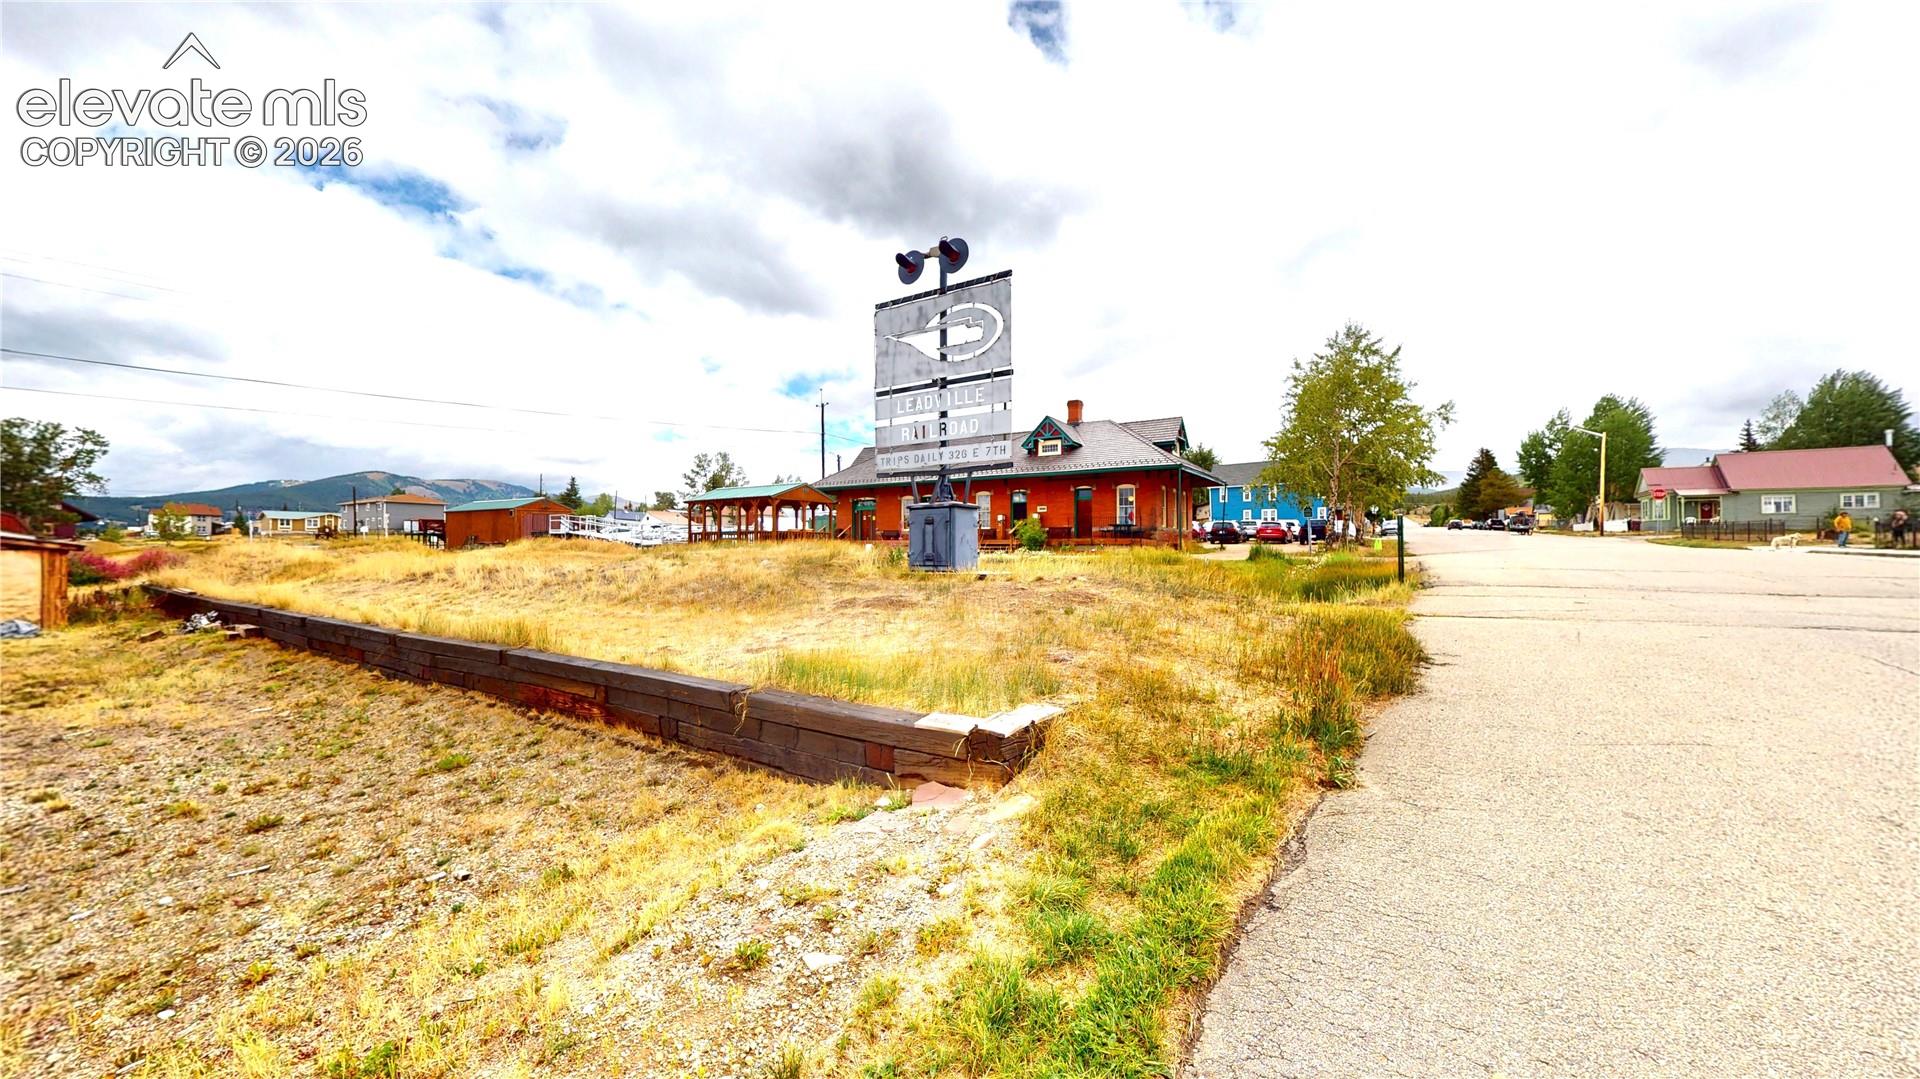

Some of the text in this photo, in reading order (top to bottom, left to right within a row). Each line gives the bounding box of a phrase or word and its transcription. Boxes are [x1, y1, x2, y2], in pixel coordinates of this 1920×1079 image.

[896, 387, 985, 414] LEADVILLE
[901, 419, 979, 441] RAILROAD
[880, 455, 910, 466] TRIPS
[914, 451, 944, 464] DAILY
[972, 447, 980, 458] E
[985, 445, 1007, 457] 7TH
